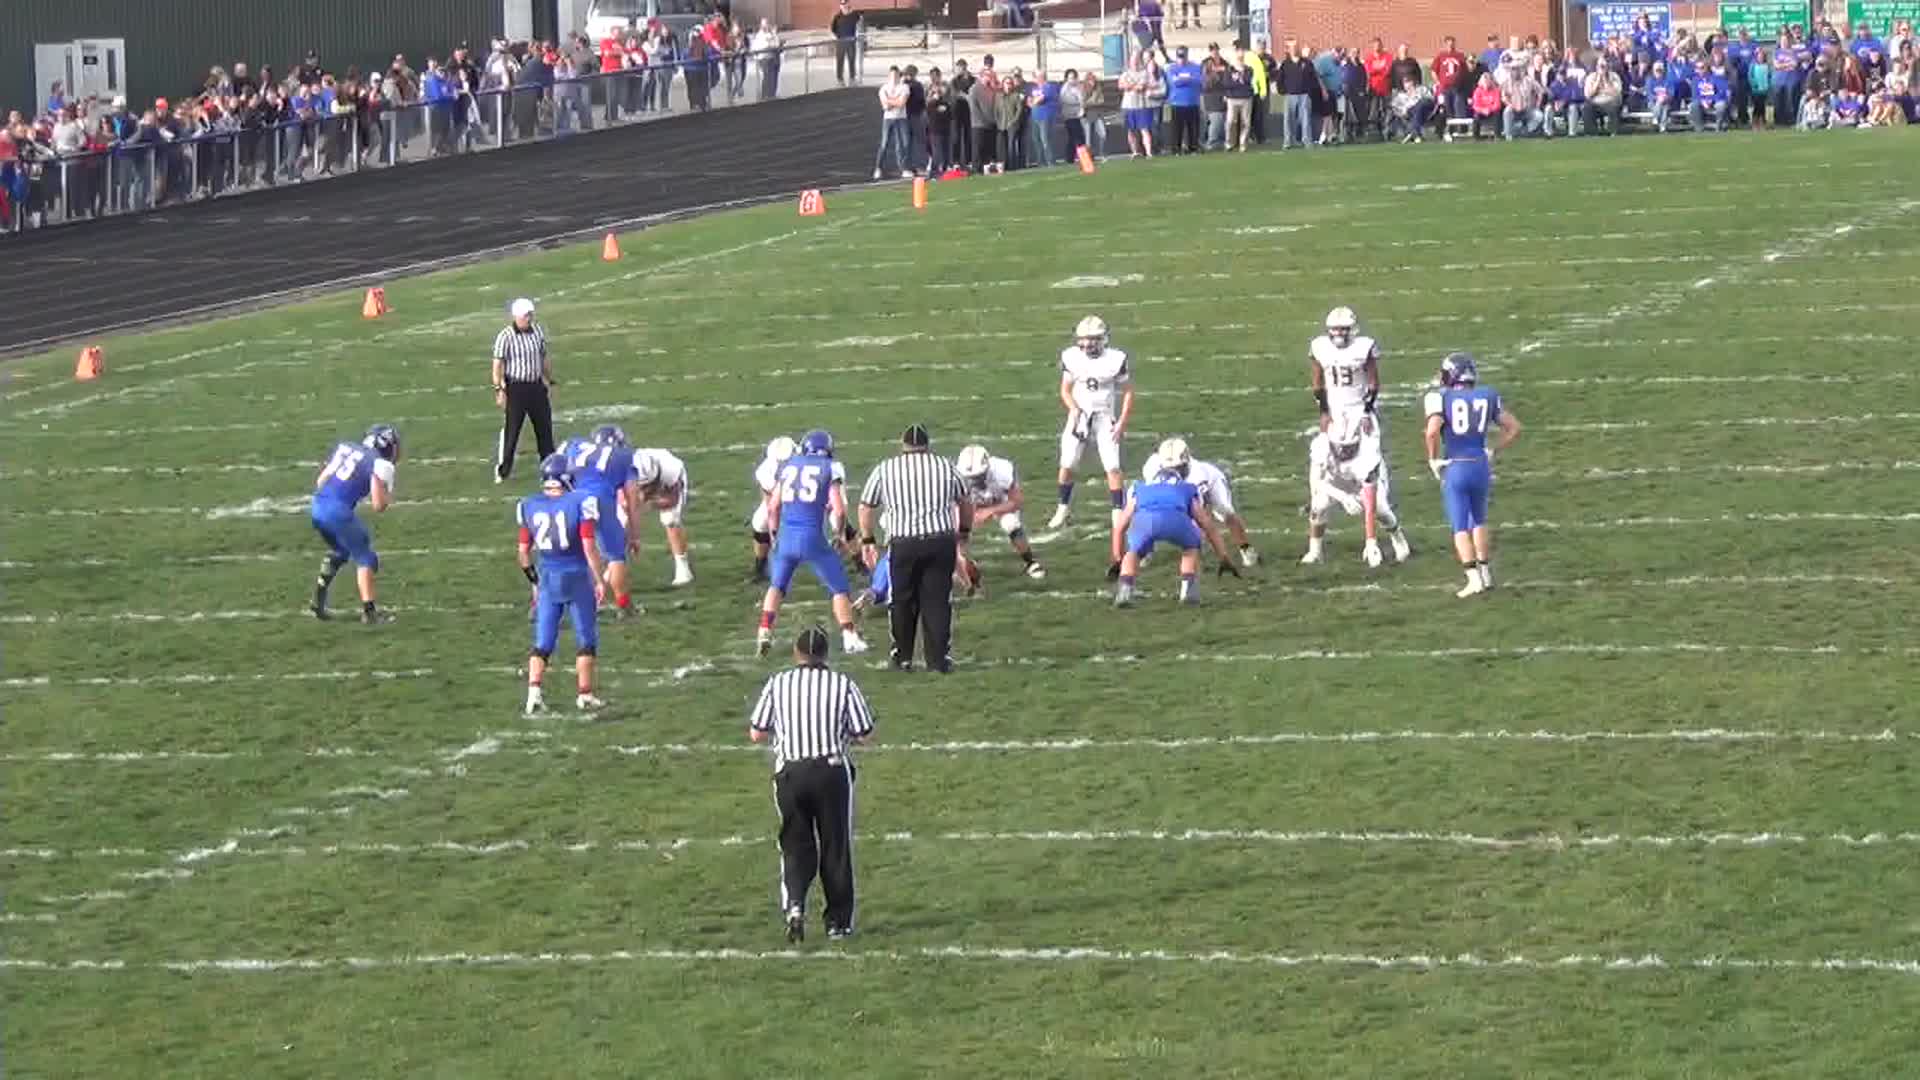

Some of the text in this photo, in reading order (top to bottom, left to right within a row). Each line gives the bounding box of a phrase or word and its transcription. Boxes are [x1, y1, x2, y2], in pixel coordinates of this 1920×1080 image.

[1332, 365, 1353, 387] 13
[1452, 398, 1488, 434] 87
[575, 442, 612, 471] 71
[780, 464, 821, 502] 25
[533, 511, 569, 549] 21
